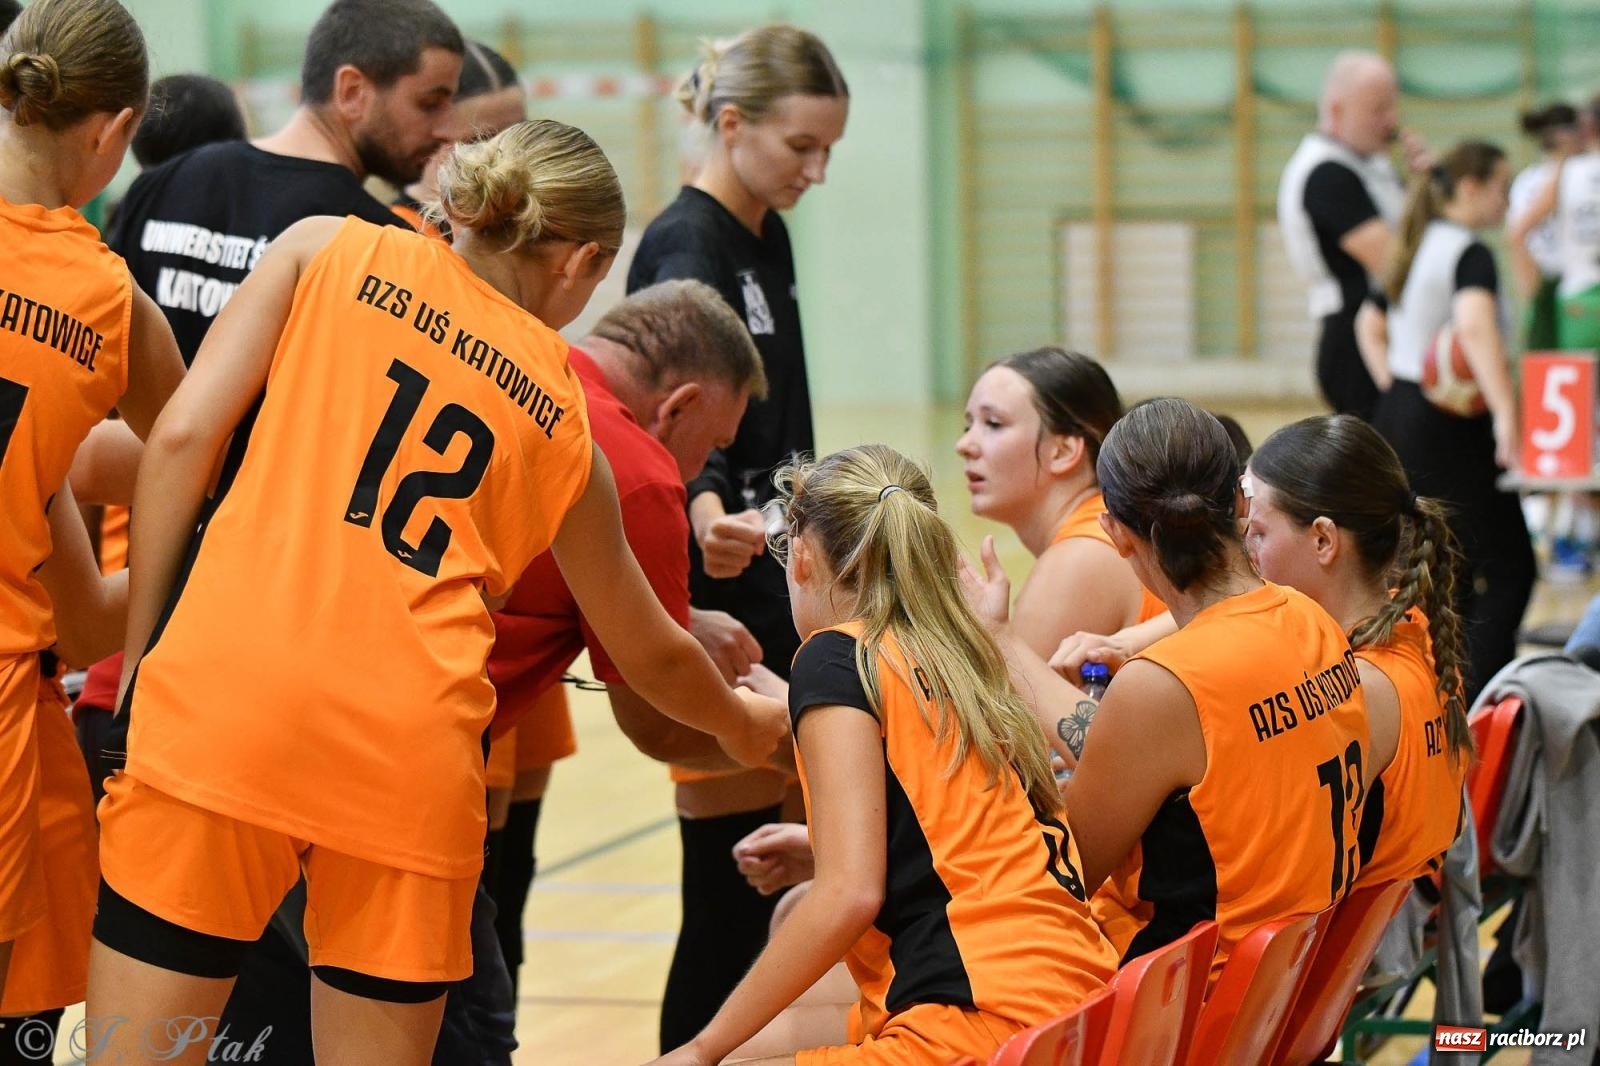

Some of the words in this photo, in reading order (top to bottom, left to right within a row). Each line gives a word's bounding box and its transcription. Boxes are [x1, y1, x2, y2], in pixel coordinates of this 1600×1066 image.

[0, 289, 104, 372] ATOWICE
[357, 274, 412, 318] AZS
[413, 302, 450, 345] UŚ
[451, 329, 564, 439] KATOWICE
[344, 358, 495, 577] 12
[1530, 365, 1580, 450] 5
[1248, 692, 1297, 742] AZS
[1294, 671, 1324, 721] UŚ
[1315, 649, 1361, 711] KATOWIC
[1317, 740, 1365, 905] 13
